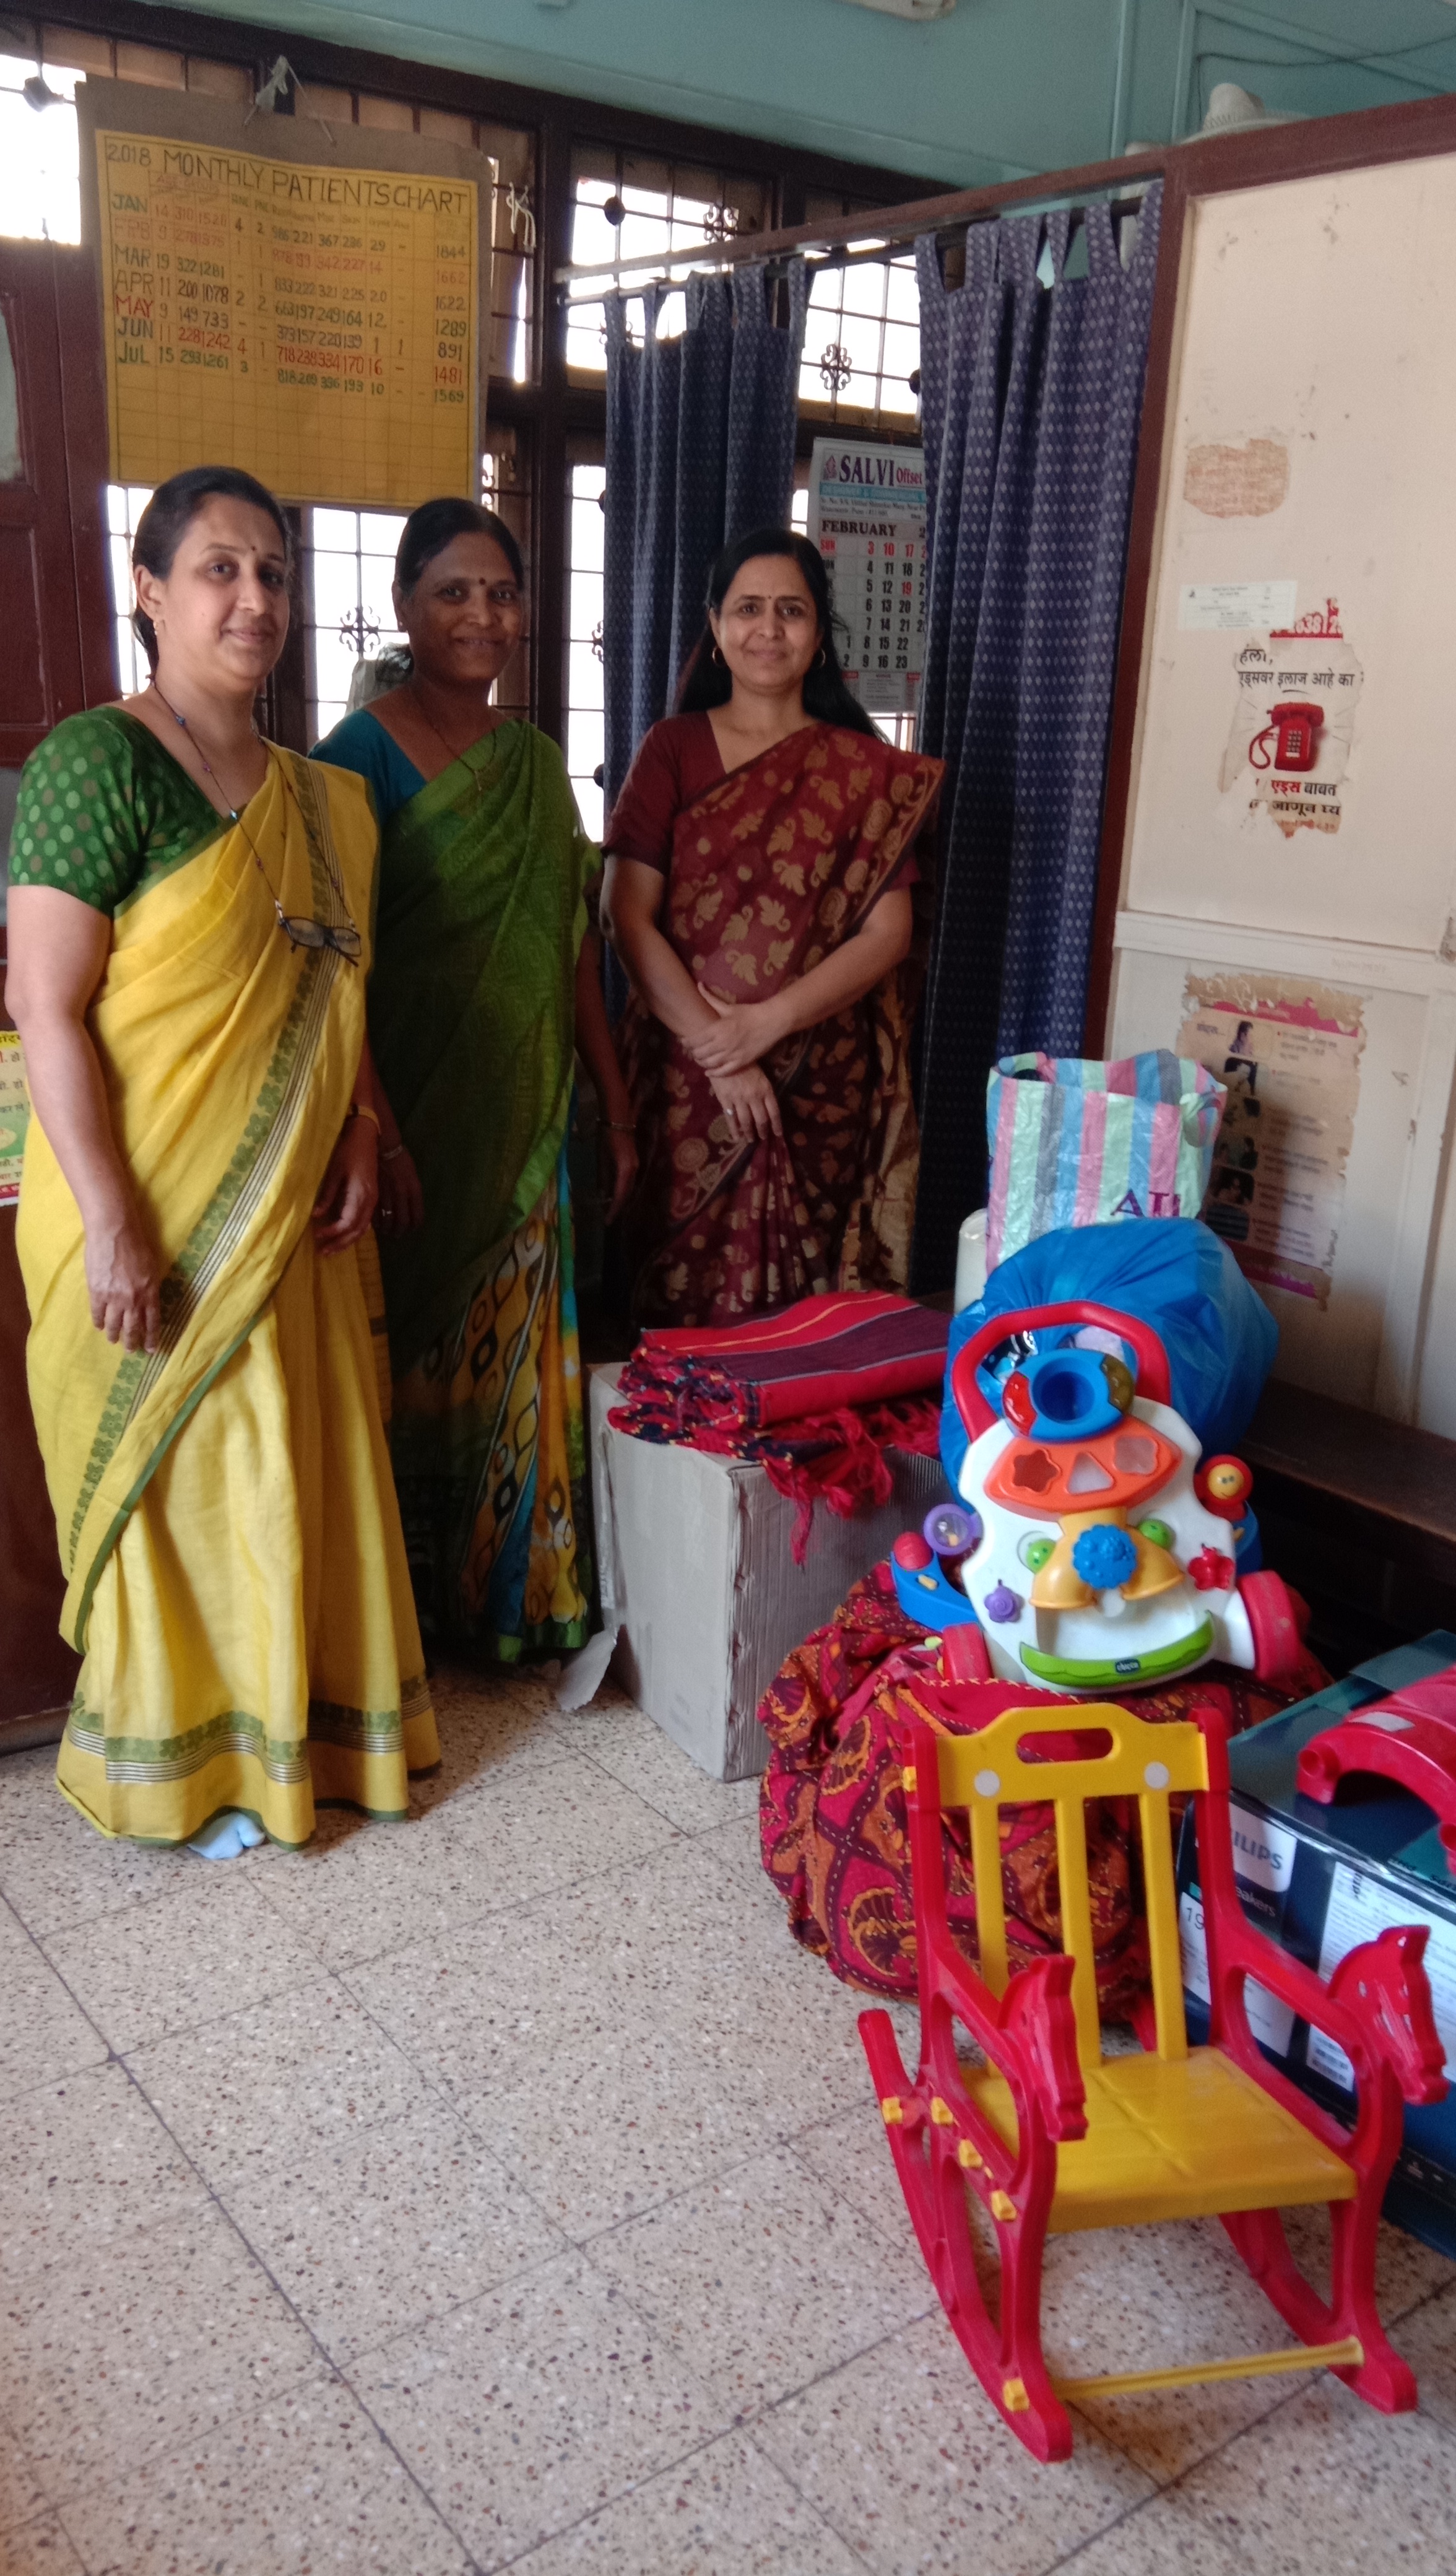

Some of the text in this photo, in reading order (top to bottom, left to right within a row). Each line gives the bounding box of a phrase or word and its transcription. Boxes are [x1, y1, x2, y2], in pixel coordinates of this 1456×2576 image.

[108, 144, 150, 167] 2018
[164, 149, 264, 189] MONTHLY
[113, 193, 148, 213] JAN
[235, 217, 243, 232] 4
[436, 245, 466, 259] 1844
[114, 243, 151, 268] MAR
[157, 253, 170, 269] 19
[370, 290, 388, 302] 20
[435, 295, 466, 311] 1622
[436, 270, 466, 285] 1662
[114, 269, 154, 295] APR
[160, 276, 170, 297] 11
[177, 278, 198, 298] 200
[201, 282, 229, 304] 1078
[235, 290, 245, 306] 2
[257, 295, 268, 312] 2
[435, 318, 467, 337] 1289
[114, 293, 155, 319] MAY
[178, 305, 198, 323] 149
[202, 310, 229, 330] 733
[297, 327, 316, 344] 157
[437, 341, 463, 363] 891
[117, 316, 154, 339] JUN
[238, 337, 247, 355] 4
[343, 355, 365, 375] 170
[369, 357, 384, 376] 16
[434, 365, 463, 385] 1481
[159, 346, 175, 363] 15
[240, 360, 249, 373] 3
[371, 381, 385, 396] 10
[434, 388, 464, 403] 1569
[839, 455, 923, 487] SALVI Offset
[821, 519, 897, 537] FEBRUARY
[820, 538, 835, 550] SUN
[867, 541, 875, 555] 3
[883, 542, 895, 556] 10
[906, 544, 914, 558] 17
[867, 560, 873, 574] 4
[884, 562, 895, 575] 11
[902, 562, 913, 577] 18
[866, 578, 873, 593] 5
[882, 580, 893, 594] 12
[901, 581, 912, 595] 19
[865, 598, 873, 612] 6
[882, 598, 892, 612] 13
[899, 599, 911, 614] 20
[867, 616, 872, 631] 7
[880, 617, 891, 632] 14
[899, 619, 911, 632] 21
[846, 635, 909, 650] 1 8 15 22
[844, 653, 908, 669] 2 9 16 23
[1312, 667, 1335, 689] आहे
[1338, 673, 1356, 686] का
[1304, 781, 1337, 796] बाबत
[1234, 1830, 1284, 1871] ILIPS
[1235, 1885, 1276, 1917] eakers
